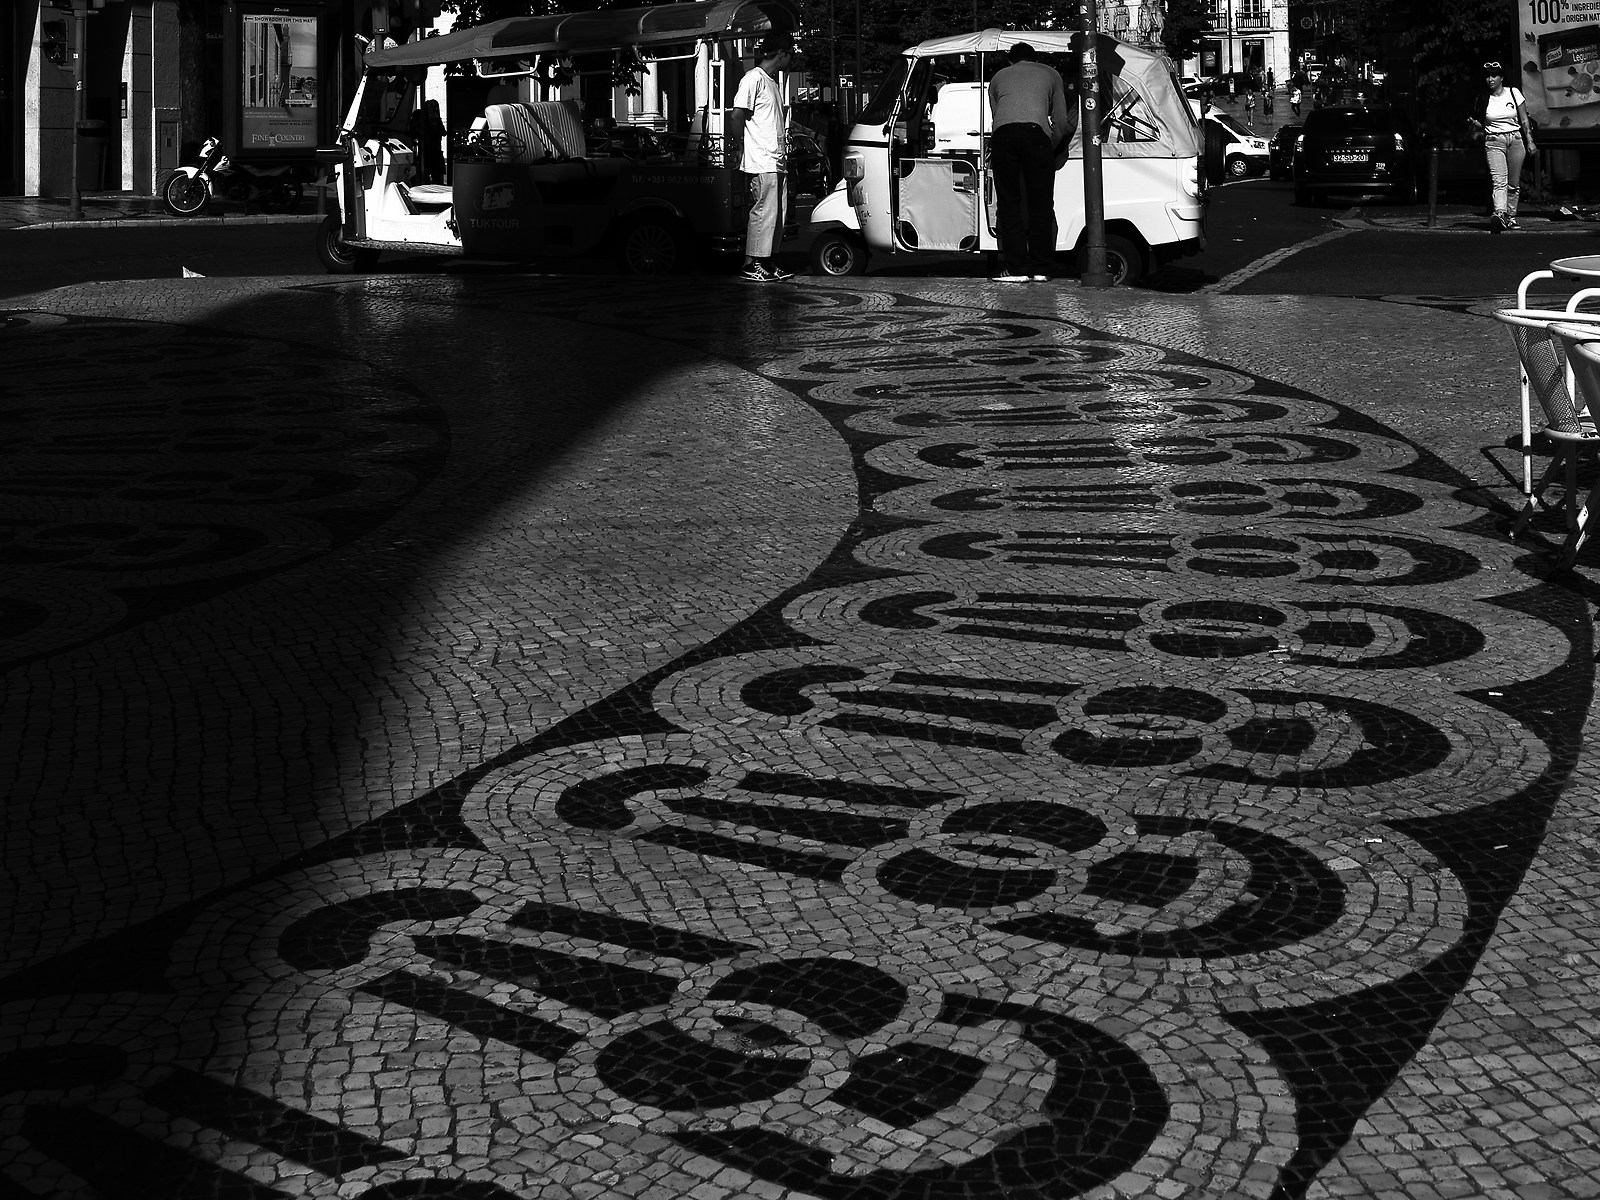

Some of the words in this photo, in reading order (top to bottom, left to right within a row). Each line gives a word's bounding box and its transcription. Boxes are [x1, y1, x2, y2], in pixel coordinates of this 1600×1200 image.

[1566, 13, 1588, 23] ORIGEM
[1572, 52, 1598, 63] Legumes
[252, 133, 269, 143] FINE
[275, 133, 306, 143] COUNTRY
[647, 175, 665, 184] +351
[470, 218, 520, 229] TUKTOUR
